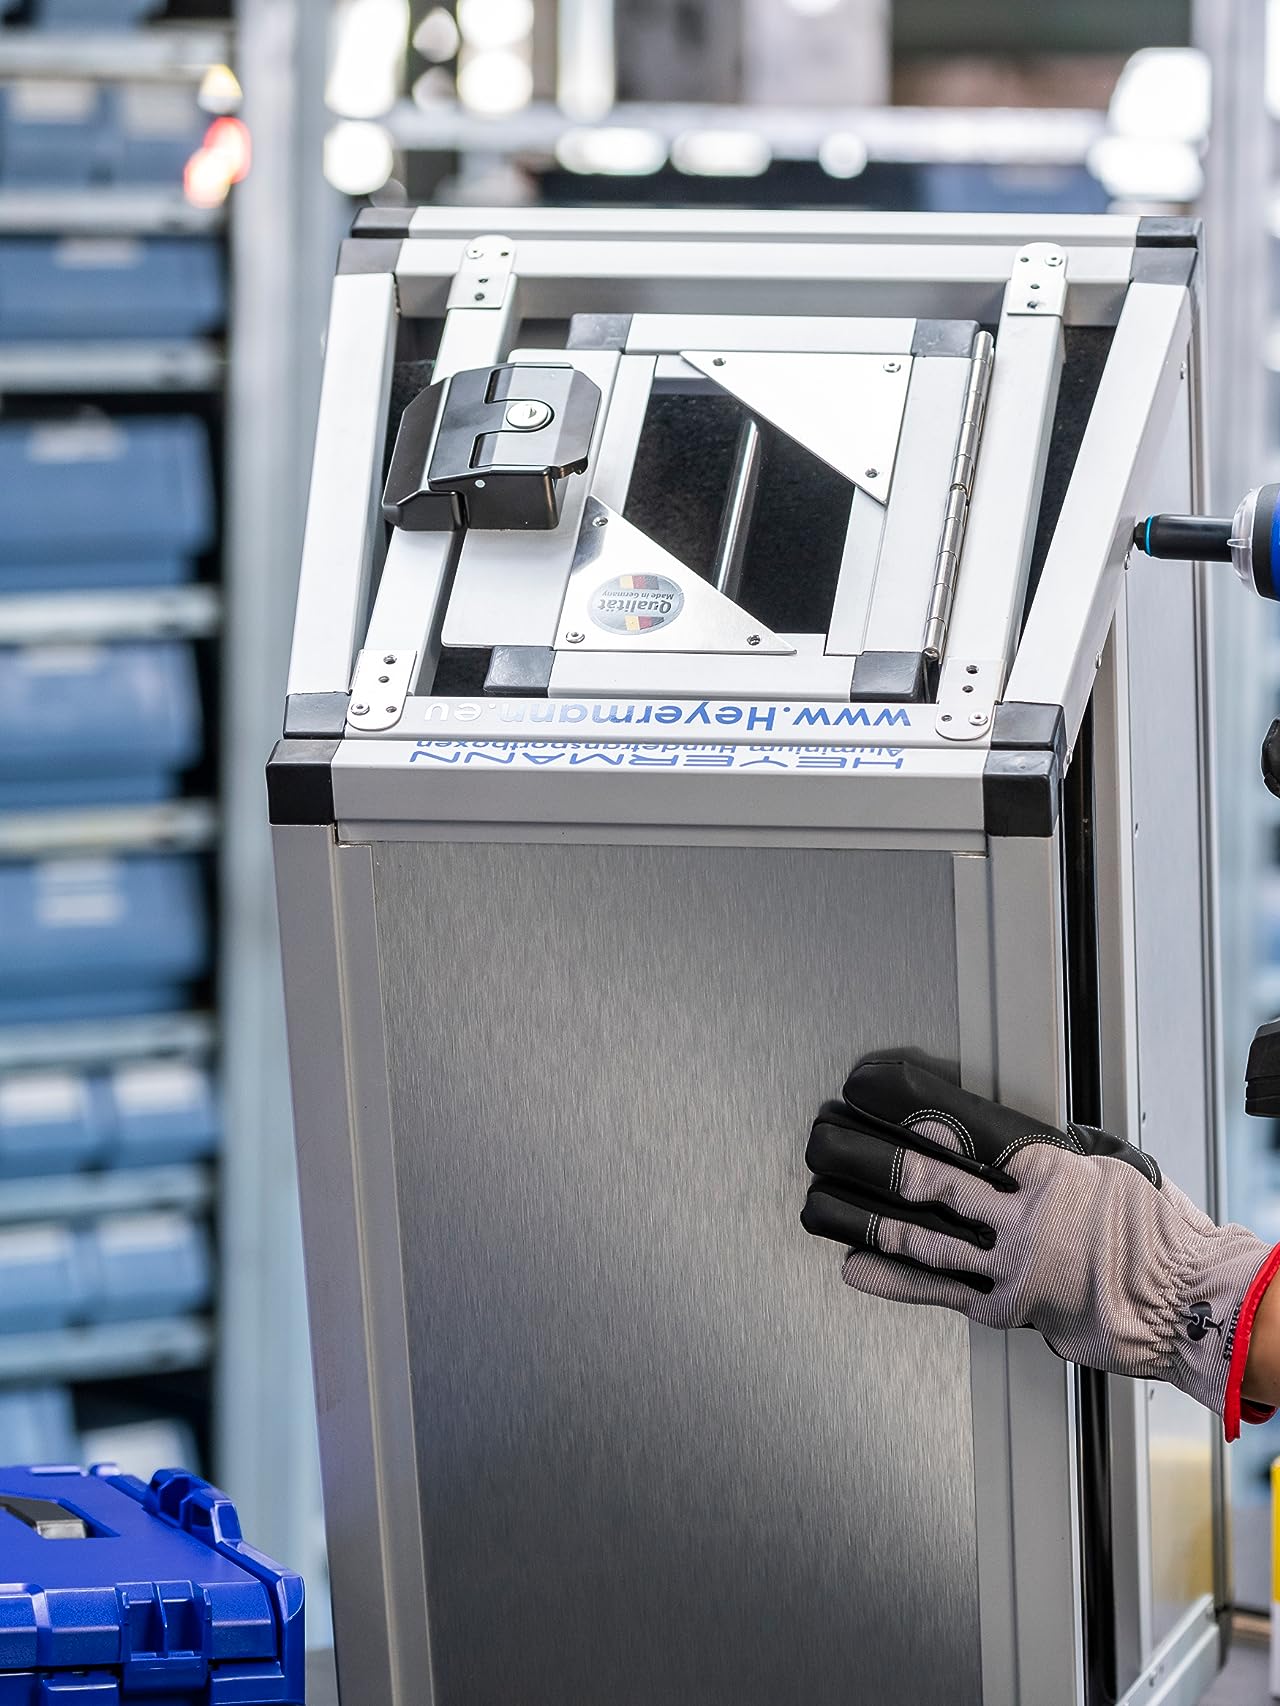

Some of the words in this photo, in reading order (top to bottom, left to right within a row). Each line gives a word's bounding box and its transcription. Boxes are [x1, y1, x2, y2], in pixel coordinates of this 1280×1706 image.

[602, 590, 640, 599] Germany
[641, 591, 650, 599] in
[651, 592, 675, 600] Made
[598, 600, 672, 614] Qualität
[424, 700, 912, 731] www.Heyermann.eu
[409, 751, 904, 770] HEYERMANN
